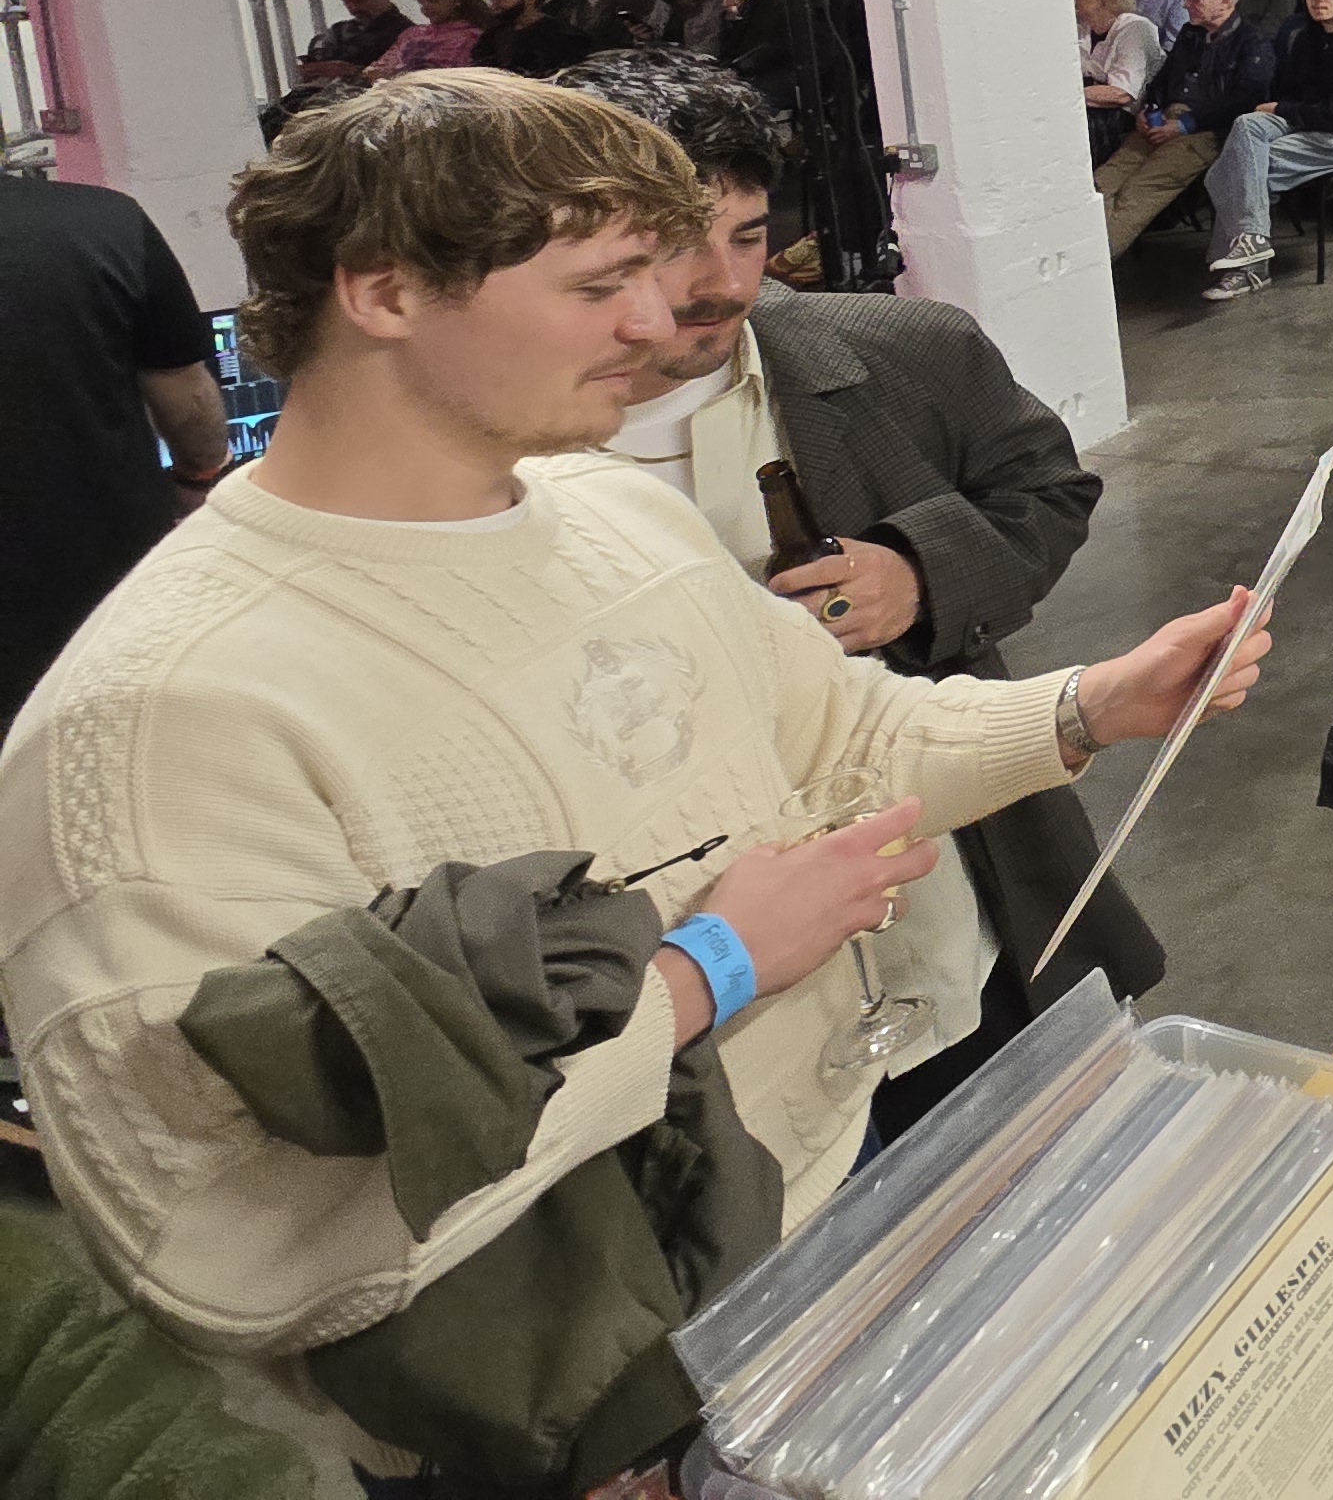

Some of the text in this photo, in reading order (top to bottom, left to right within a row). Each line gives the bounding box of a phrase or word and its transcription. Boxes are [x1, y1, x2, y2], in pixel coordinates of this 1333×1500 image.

[1160, 1234, 1333, 1446] DIZZY GILLESPIE
[1172, 1393, 1227, 1457] THELONIUS
